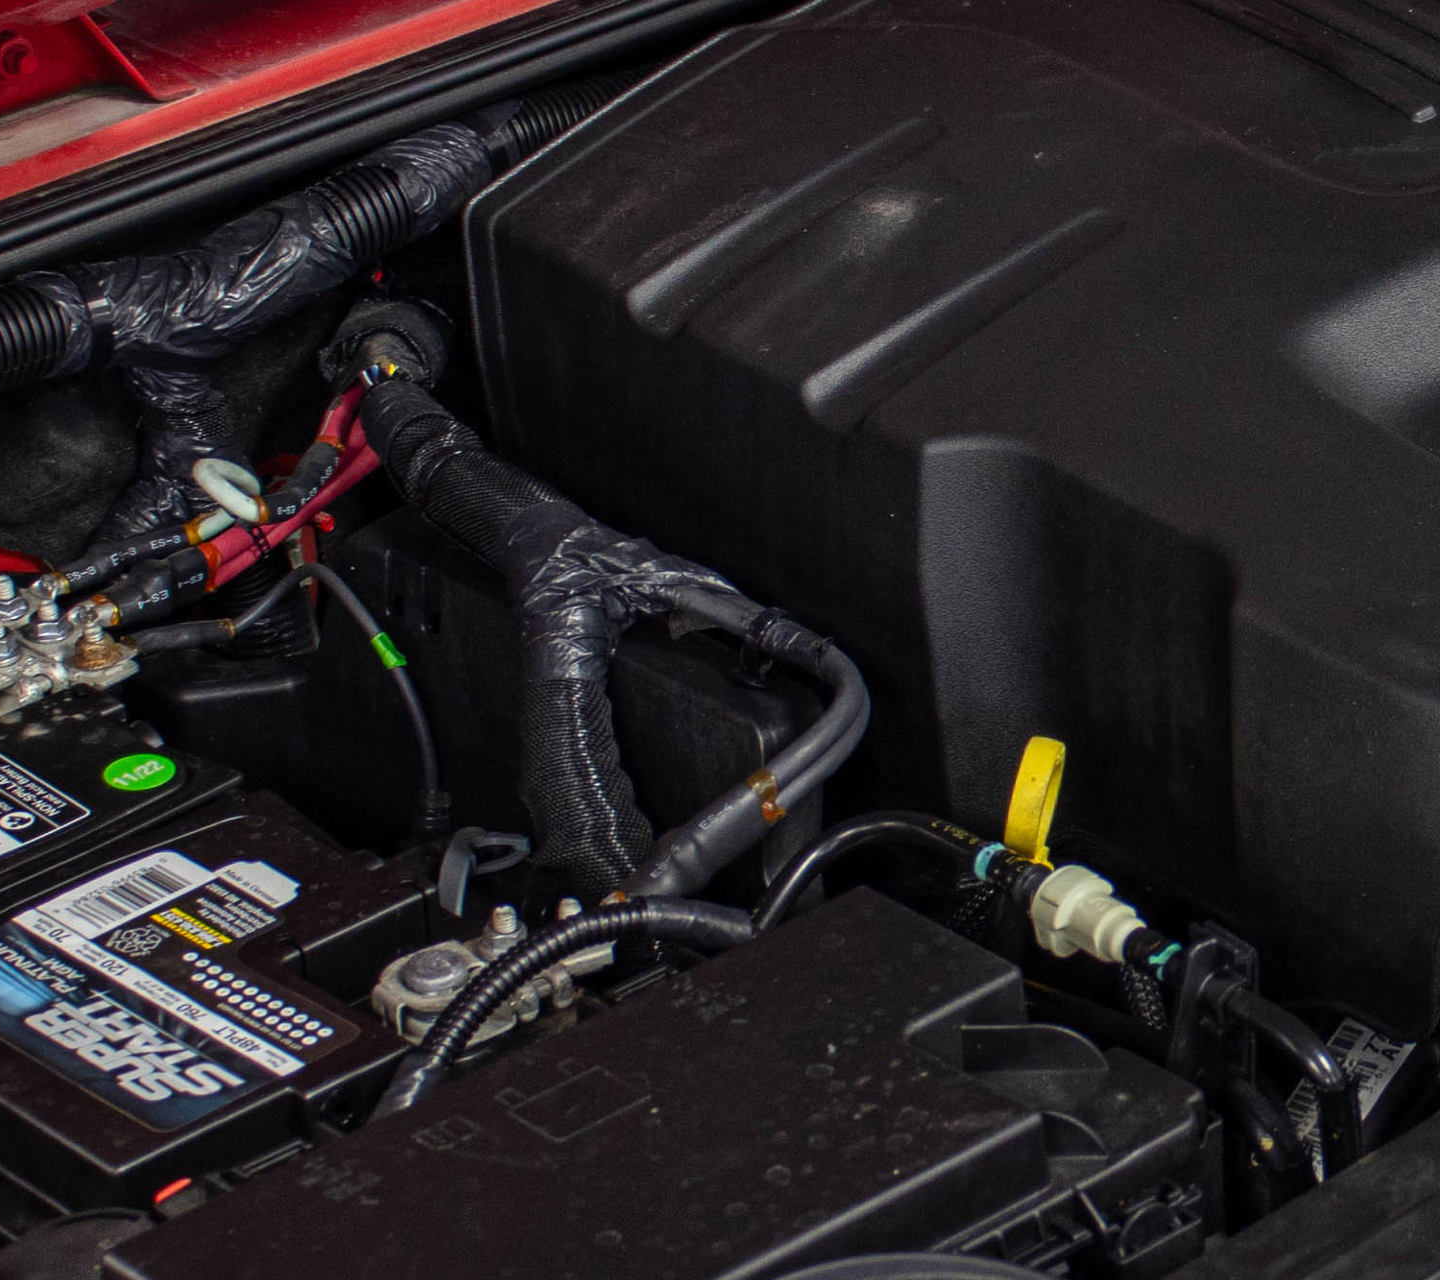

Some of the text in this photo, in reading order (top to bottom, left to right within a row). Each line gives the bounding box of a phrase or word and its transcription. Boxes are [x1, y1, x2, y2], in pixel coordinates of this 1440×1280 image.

[150, 534, 182, 552] ES-3
[45, 927, 73, 943] 70
[40, 956, 85, 981] AGM
[97, 958, 131, 976] 120
[173, 1001, 209, 1022] 760
[51, 996, 246, 1100] START
[208, 1023, 265, 1053] 48PLT
[21, 1003, 183, 1104] SUPER
